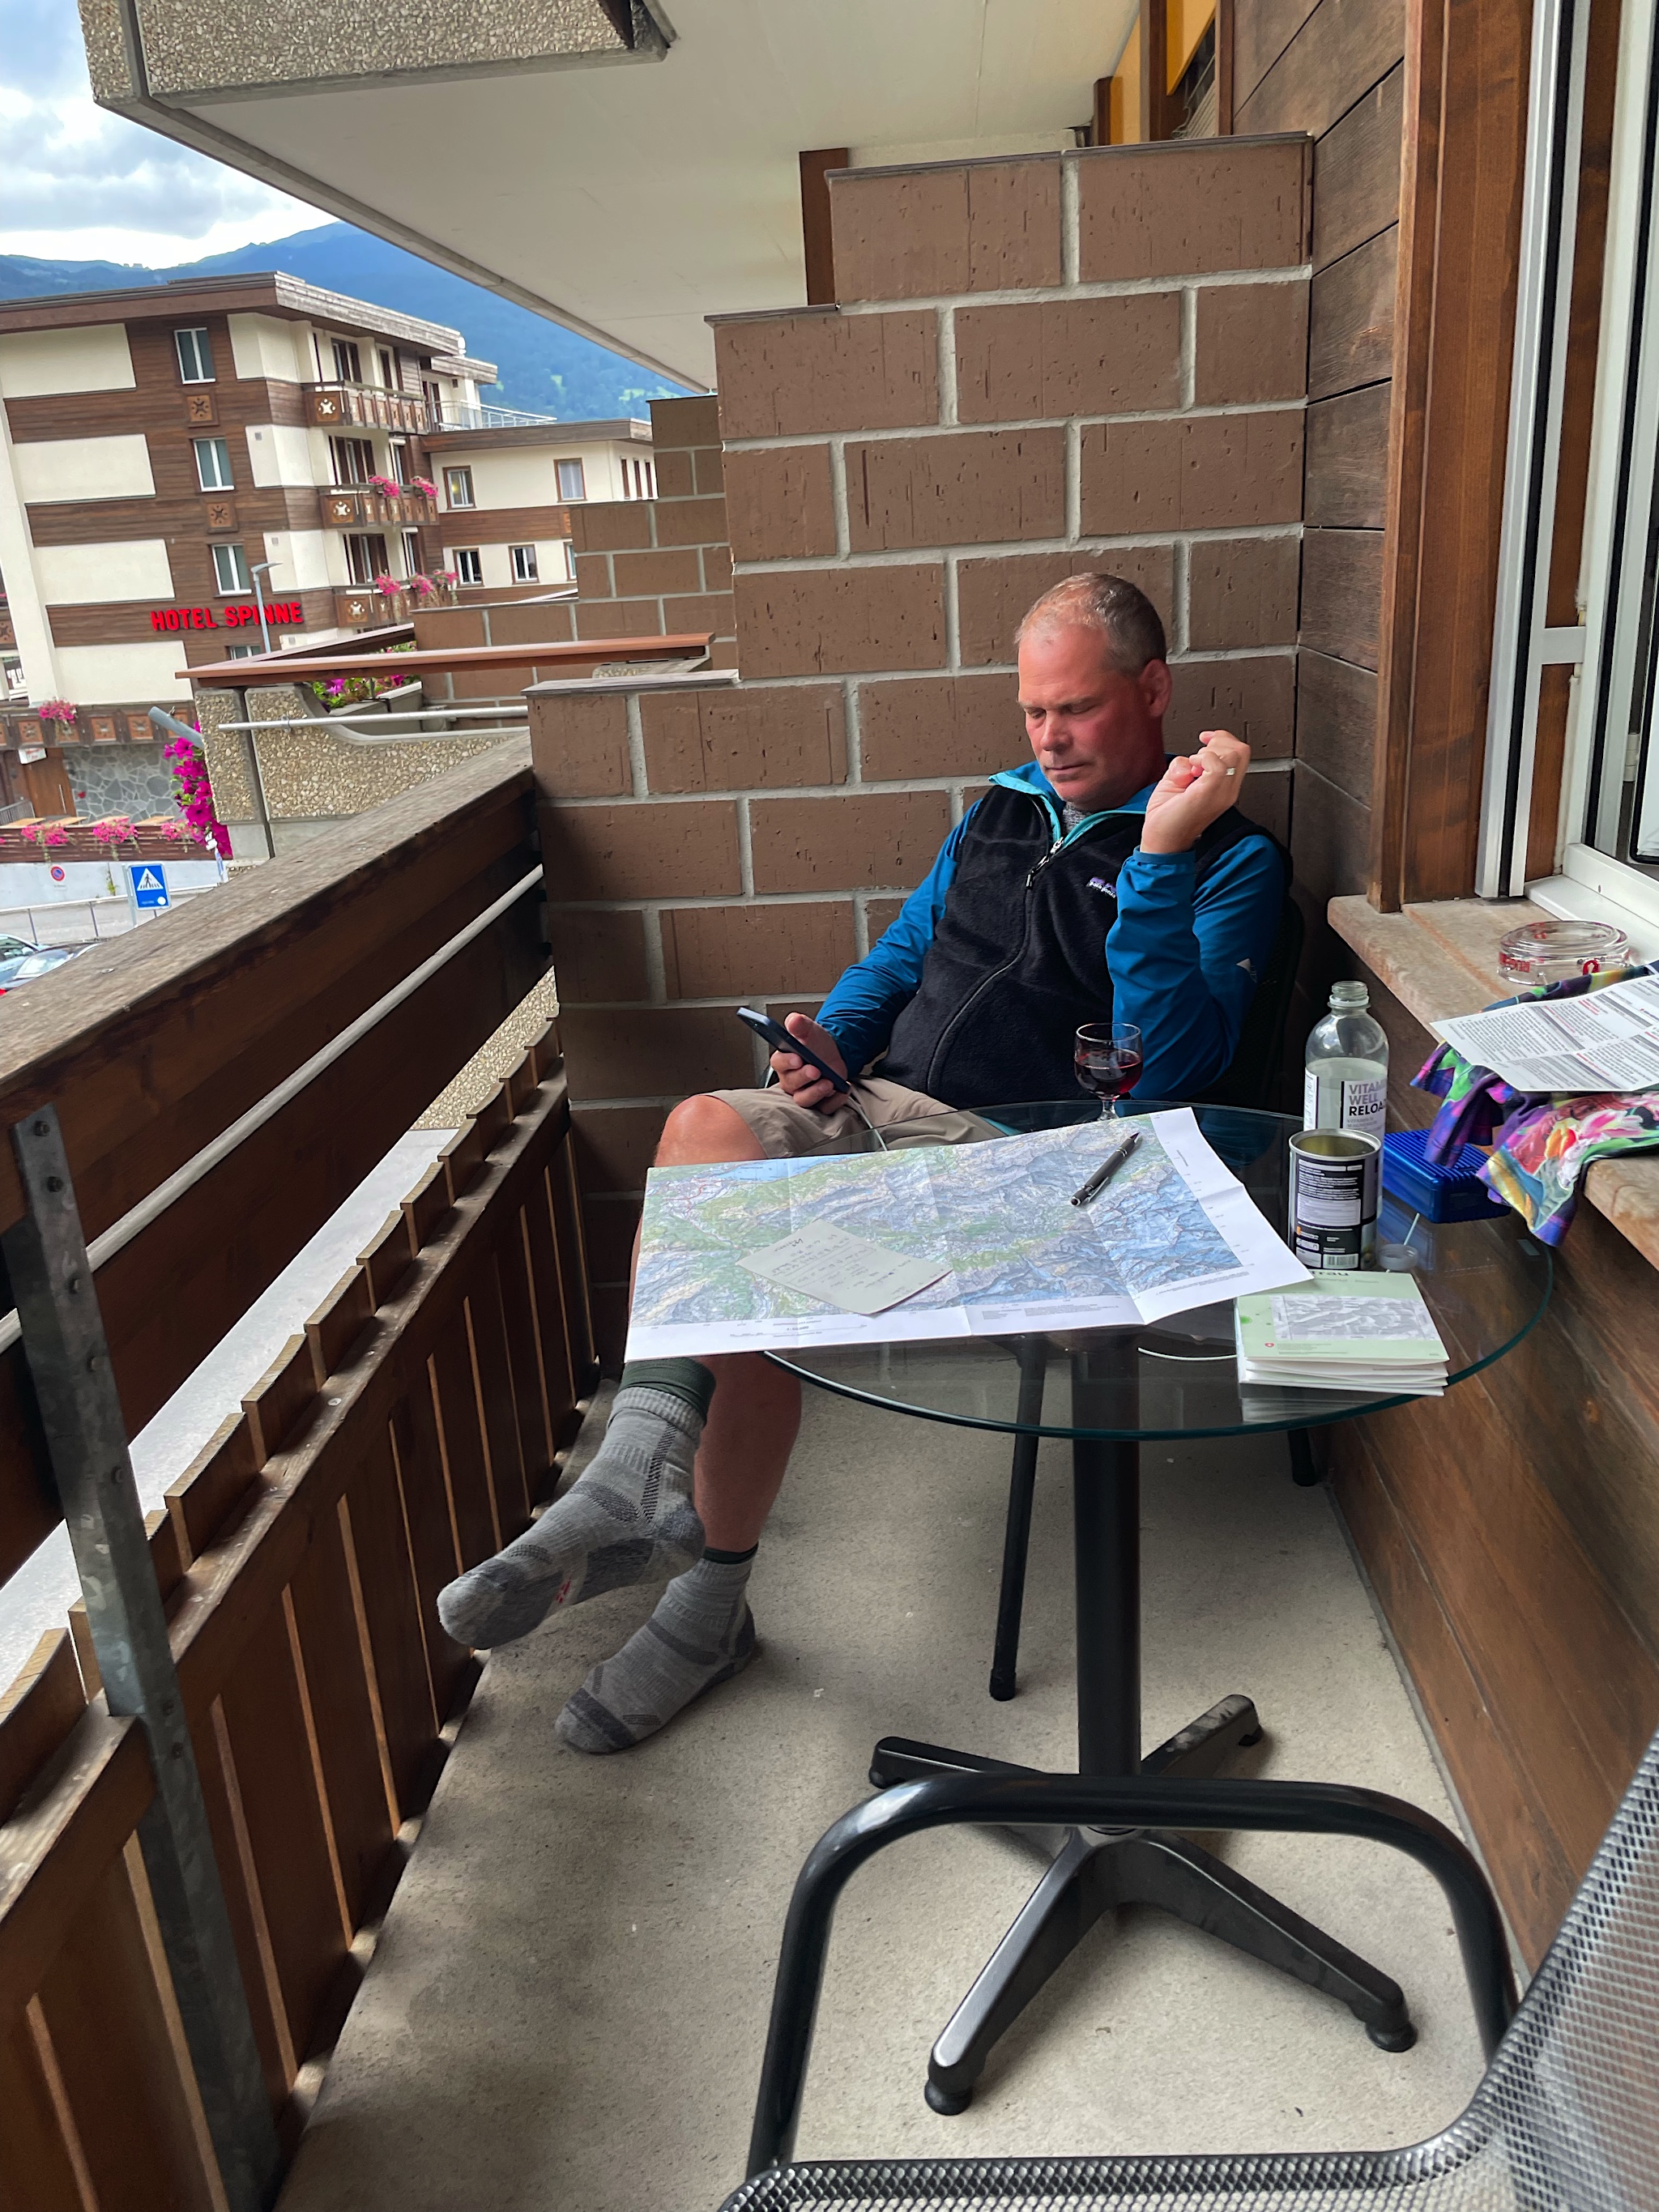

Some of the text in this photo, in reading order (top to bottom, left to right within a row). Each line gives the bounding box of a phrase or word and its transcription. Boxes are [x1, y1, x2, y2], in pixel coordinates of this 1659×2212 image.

[150, 602, 304, 632] HOTEL SPINNE
[1349, 1093, 1379, 1106] WELL
[1349, 1101, 1384, 1116] RELOA
